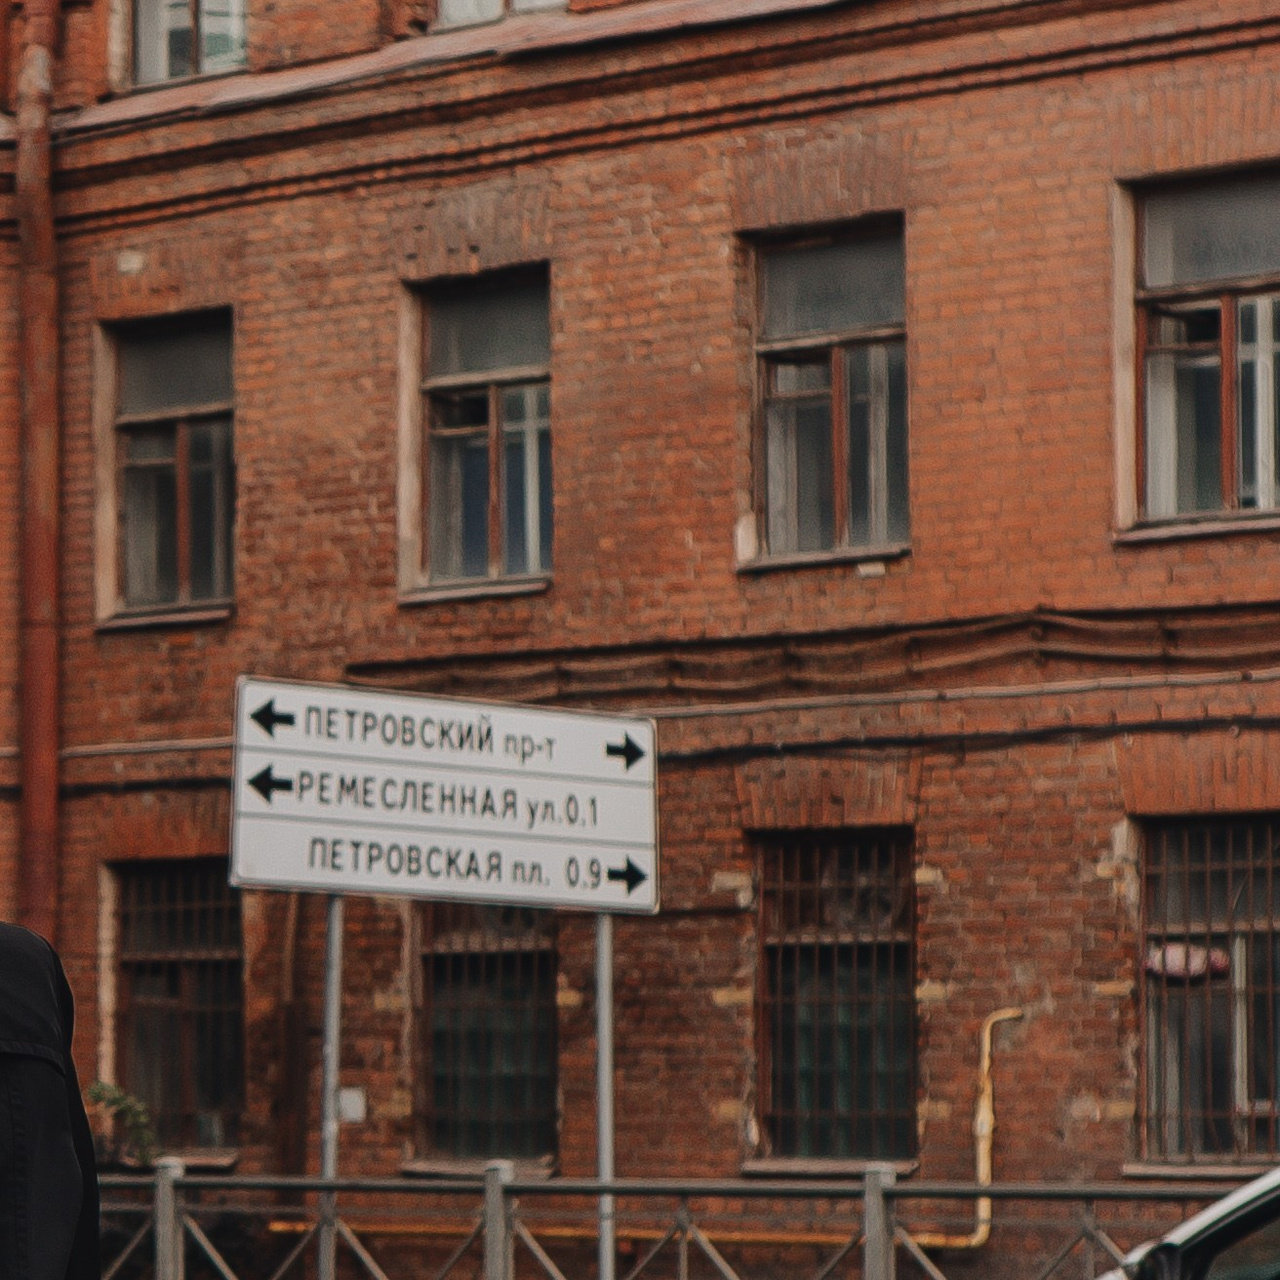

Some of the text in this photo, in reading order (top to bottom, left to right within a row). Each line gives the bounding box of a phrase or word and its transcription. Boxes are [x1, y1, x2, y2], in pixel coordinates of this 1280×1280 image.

[304, 705, 556, 765] ПЕТРОВСКИЙ пр-т
[298, 770, 518, 820] РЕМЕСЛЕННАЯ
[309, 836, 502, 883] ПЕТРОВСКАЯ
[512, 860, 550, 886] пл.
